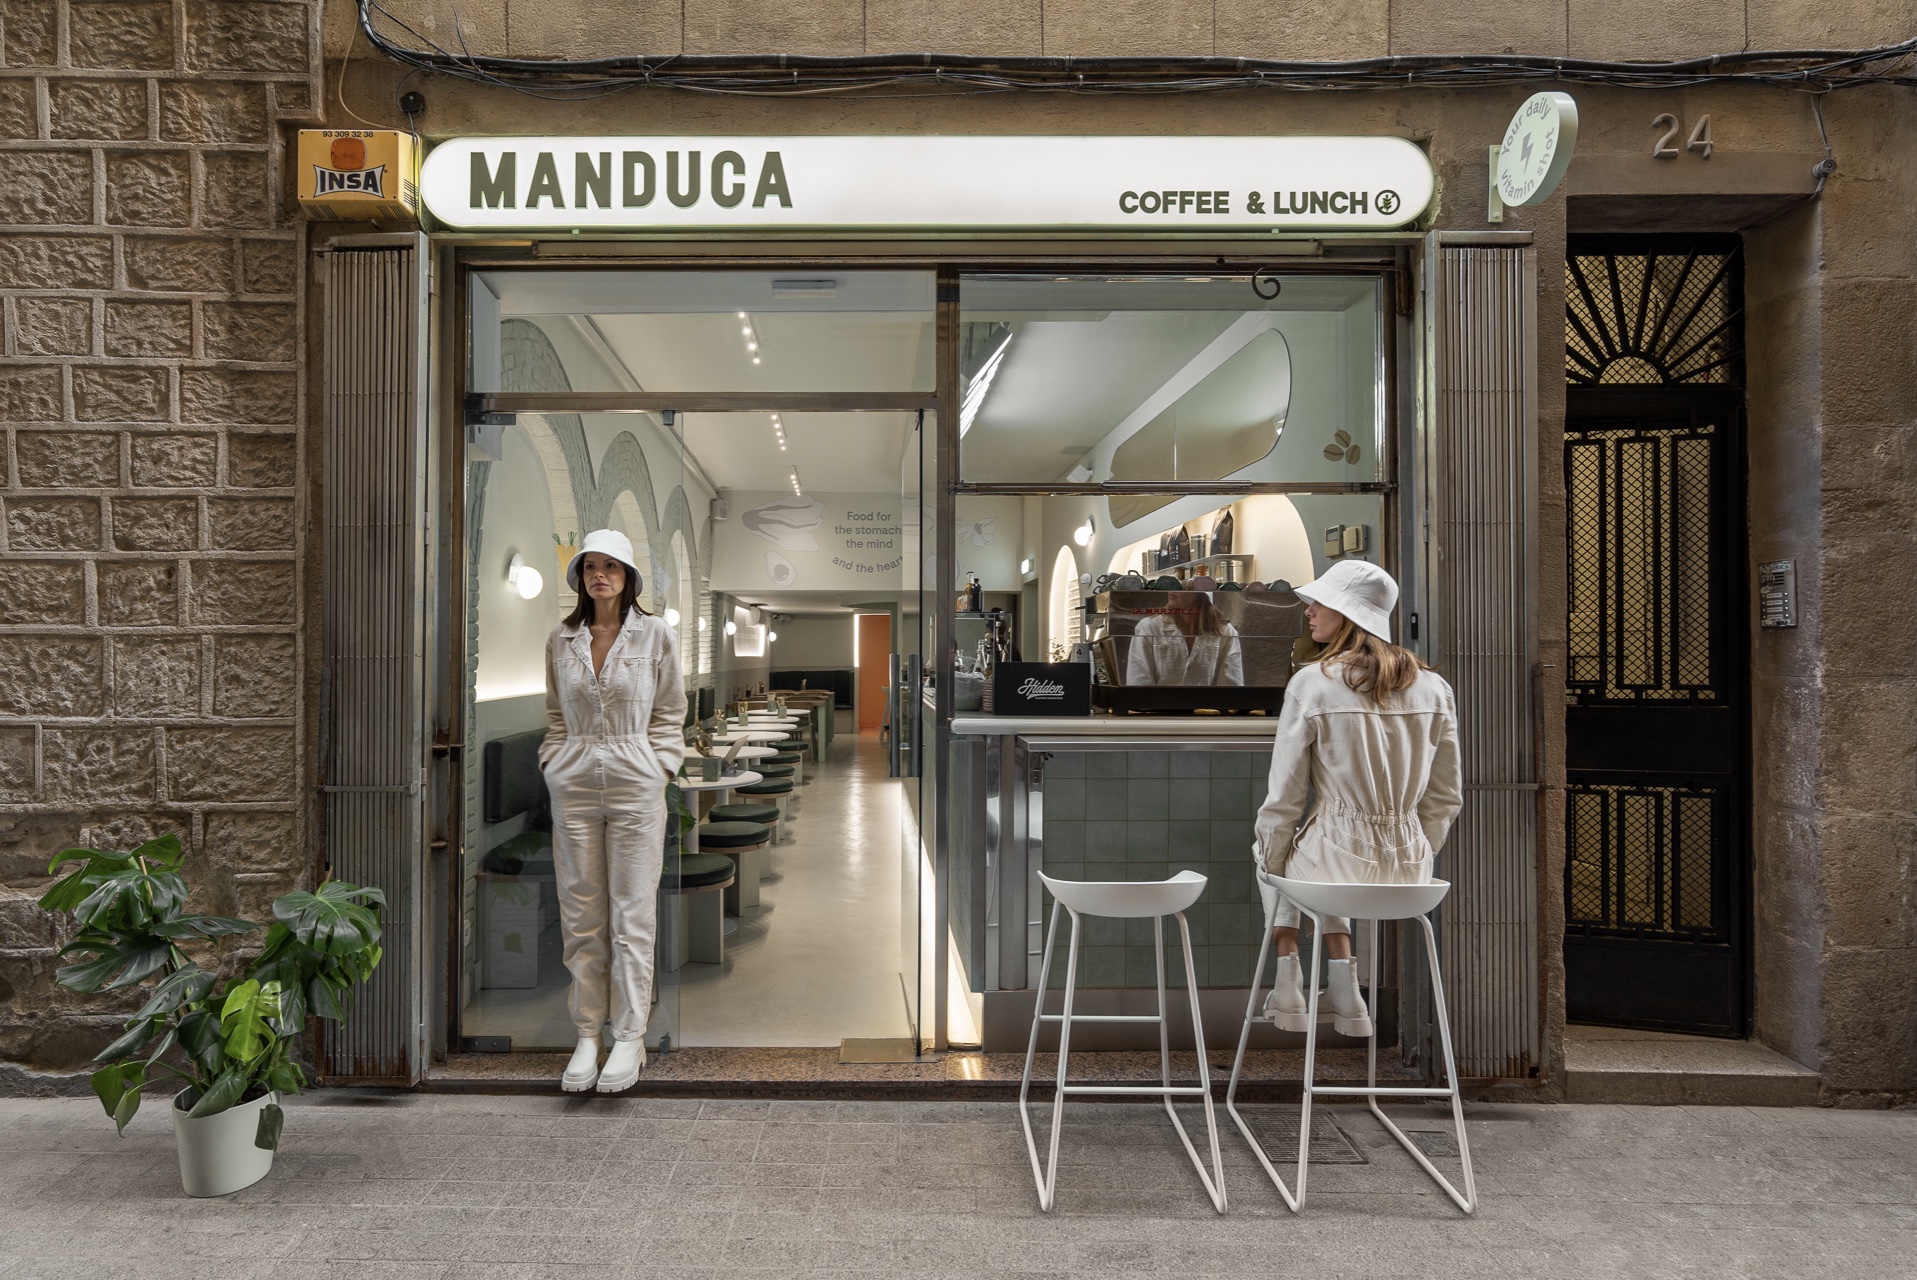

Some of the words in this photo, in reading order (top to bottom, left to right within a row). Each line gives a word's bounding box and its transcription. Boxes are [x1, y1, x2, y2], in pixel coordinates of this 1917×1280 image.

[1501, 115, 1523, 156] Your
[1526, 97, 1551, 120] daily
[1652, 113, 1714, 158] 24
[1502, 169, 1534, 199] vitamin
[1537, 127, 1554, 176] shot
[320, 170, 380, 193] INSA
[470, 150, 793, 209] MANDUCA
[1119, 191, 1230, 214] COFFEE
[1246, 191, 1266, 214] &
[1274, 191, 1368, 214] LUNCH
[847, 511, 874, 521] Food
[876, 511, 892, 521] for
[834, 525, 853, 535] the
[855, 525, 902, 535] stomach
[846, 539, 864, 549] the
[866, 539, 893, 549] mind
[832, 556, 854, 570] and
[856, 562, 874, 573] the
[1017, 677, 1065, 698] Hidden
